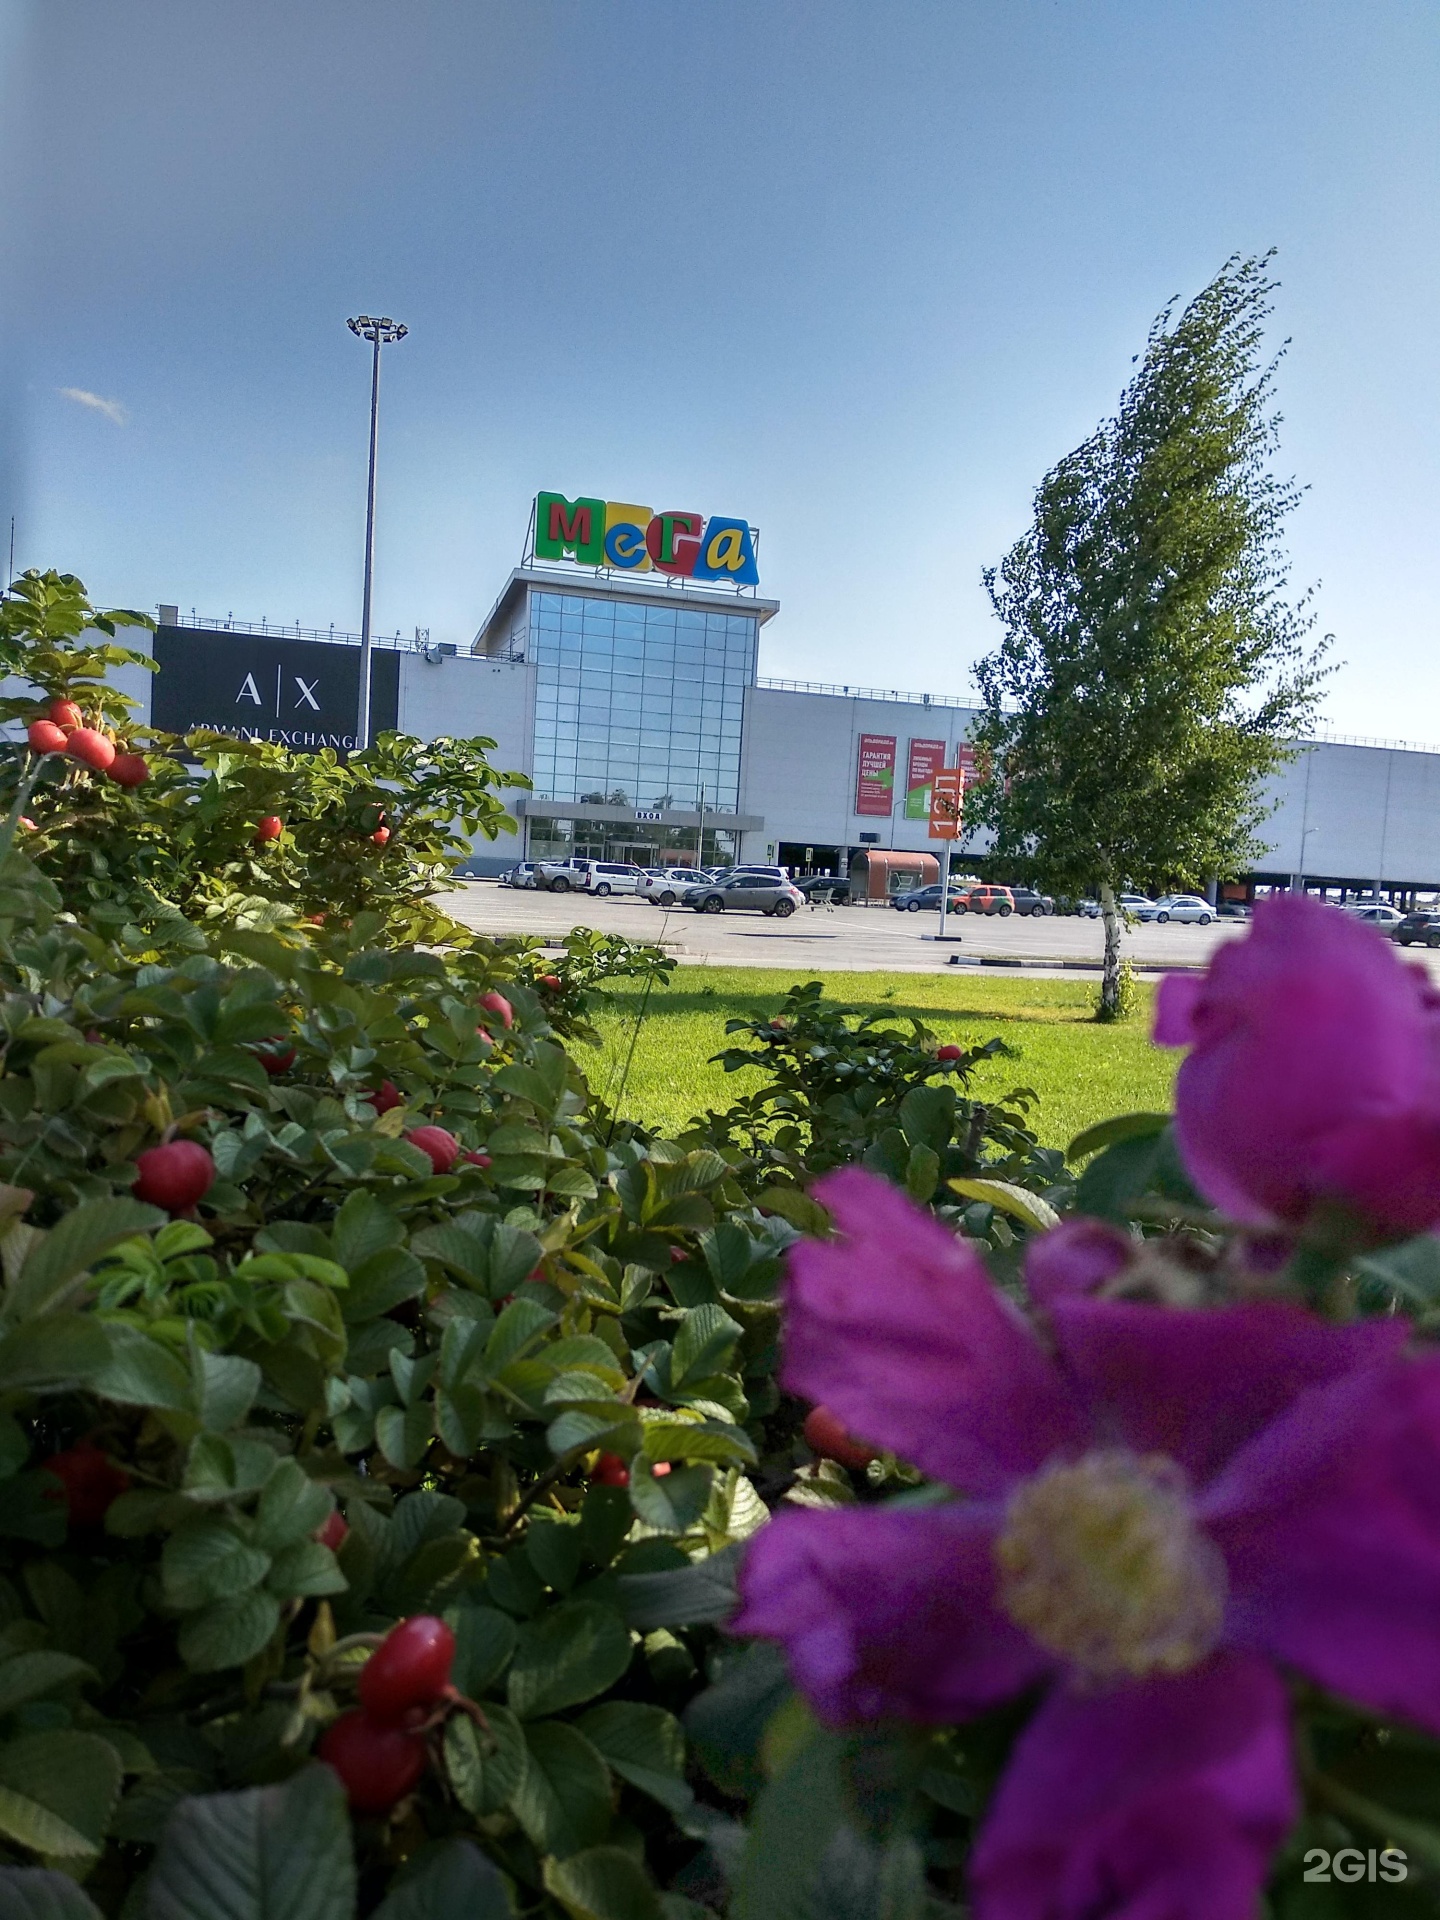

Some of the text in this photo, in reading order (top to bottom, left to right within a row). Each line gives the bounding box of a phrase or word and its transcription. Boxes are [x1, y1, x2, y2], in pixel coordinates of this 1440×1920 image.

[862, 751, 891, 760] ГАРАНТИЯ
[862, 760, 886, 768] ЛУЧШЕЙ
[861, 769, 878, 778] ЦЕНЫ
[637, 811, 660, 820] ВХОД
